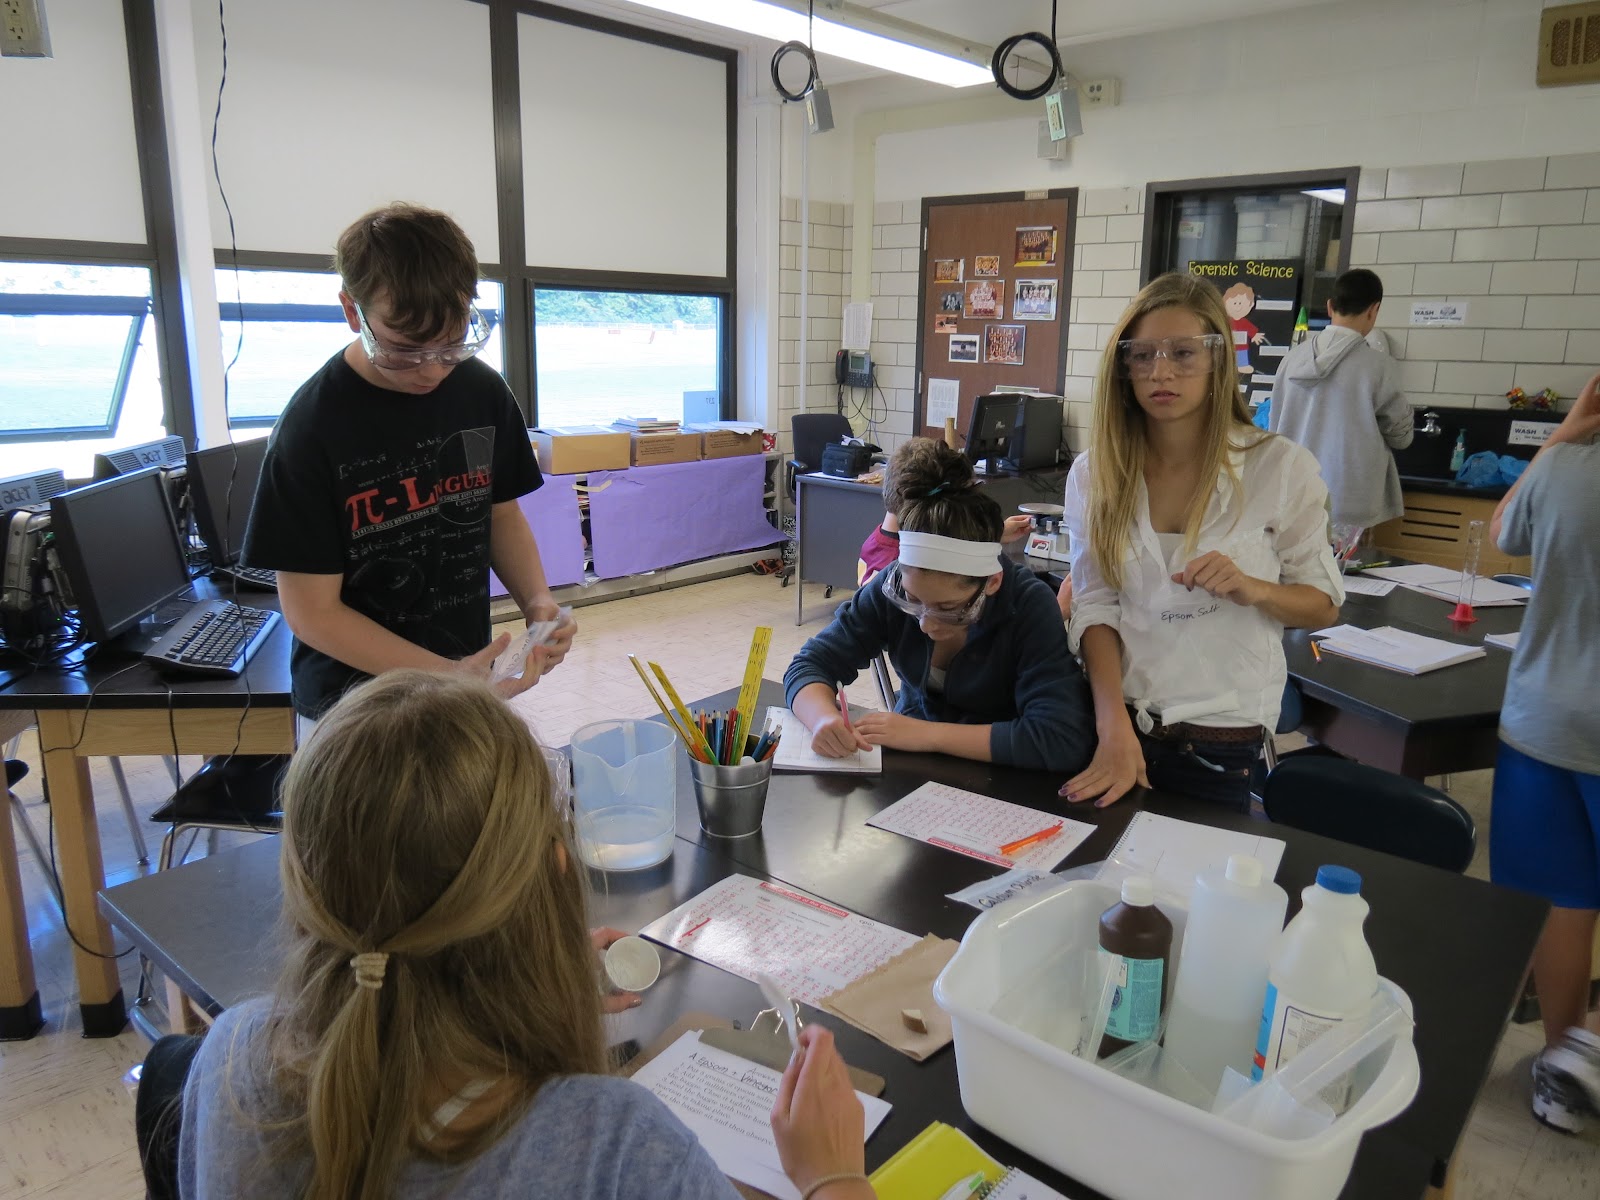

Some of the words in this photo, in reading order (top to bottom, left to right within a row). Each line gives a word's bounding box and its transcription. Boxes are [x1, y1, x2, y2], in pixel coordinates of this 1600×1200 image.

[1188, 261, 1238, 276] Forensic
[1246, 260, 1294, 278] Science
[141, 449, 161, 464] acer
[2, 485, 31, 504] acer
[1161, 610, 1194, 623] Epsom
[1198, 604, 1220, 617] Salt
[820, 904, 846, 917] Elements
[696, 1056, 729, 1074] Epsom
[668, 1072, 679, 1080] the
[681, 1070, 695, 1079] Add
[669, 1080, 684, 1090] Feel
[684, 1087, 696, 1095] the
[719, 1102, 735, 1113] with
[753, 1115, 771, 1129] hand
[669, 1096, 681, 1104] the
[714, 1117, 729, 1127] and
[729, 1122, 745, 1135] then
